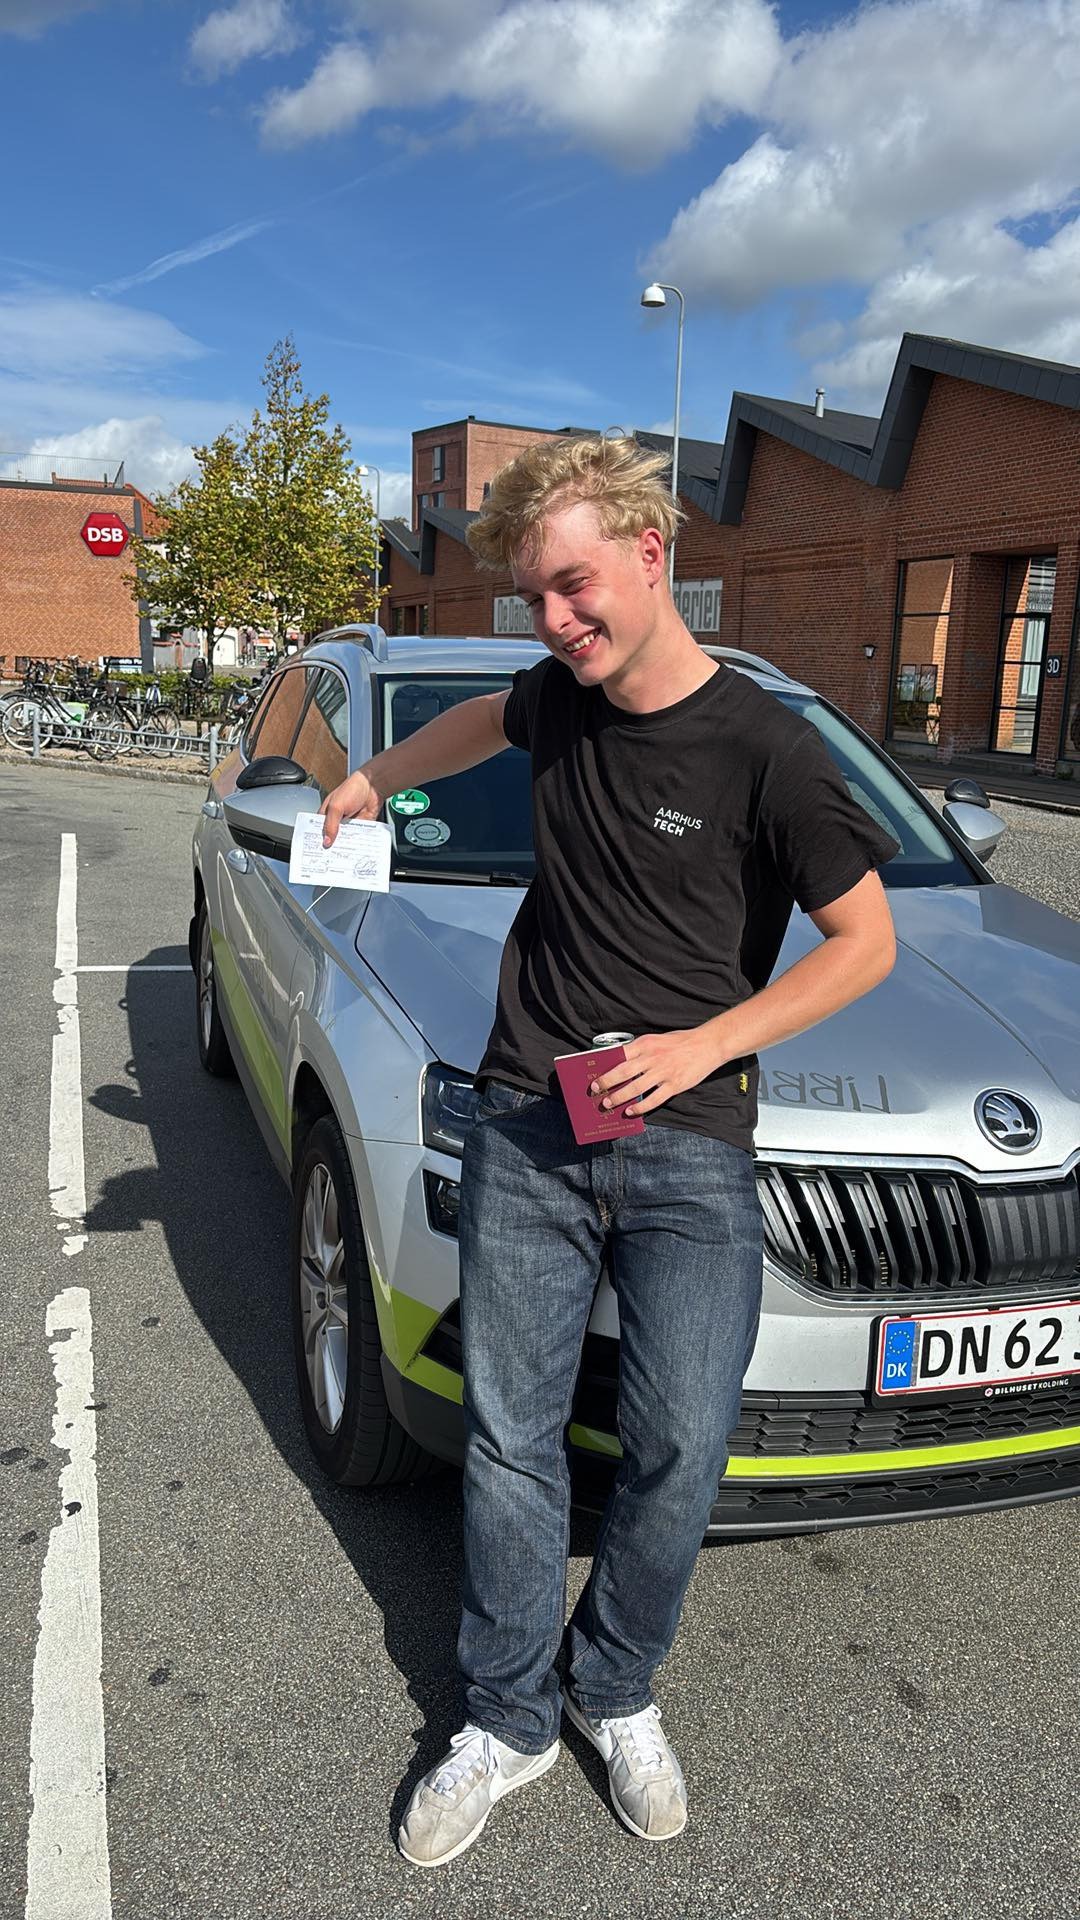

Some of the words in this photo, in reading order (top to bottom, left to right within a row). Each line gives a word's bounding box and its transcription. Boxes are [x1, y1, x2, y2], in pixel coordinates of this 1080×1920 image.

[87, 527, 124, 542] DSB
[497, 599, 508, 632] De
[1047, 659, 1060, 673] 3D
[653, 817, 685, 837] TECH
[656, 806, 703, 830] AARHUS
[919, 1325, 992, 1378] DN
[1004, 1317, 1063, 1369] 62
[886, 1362, 907, 1378] DK
